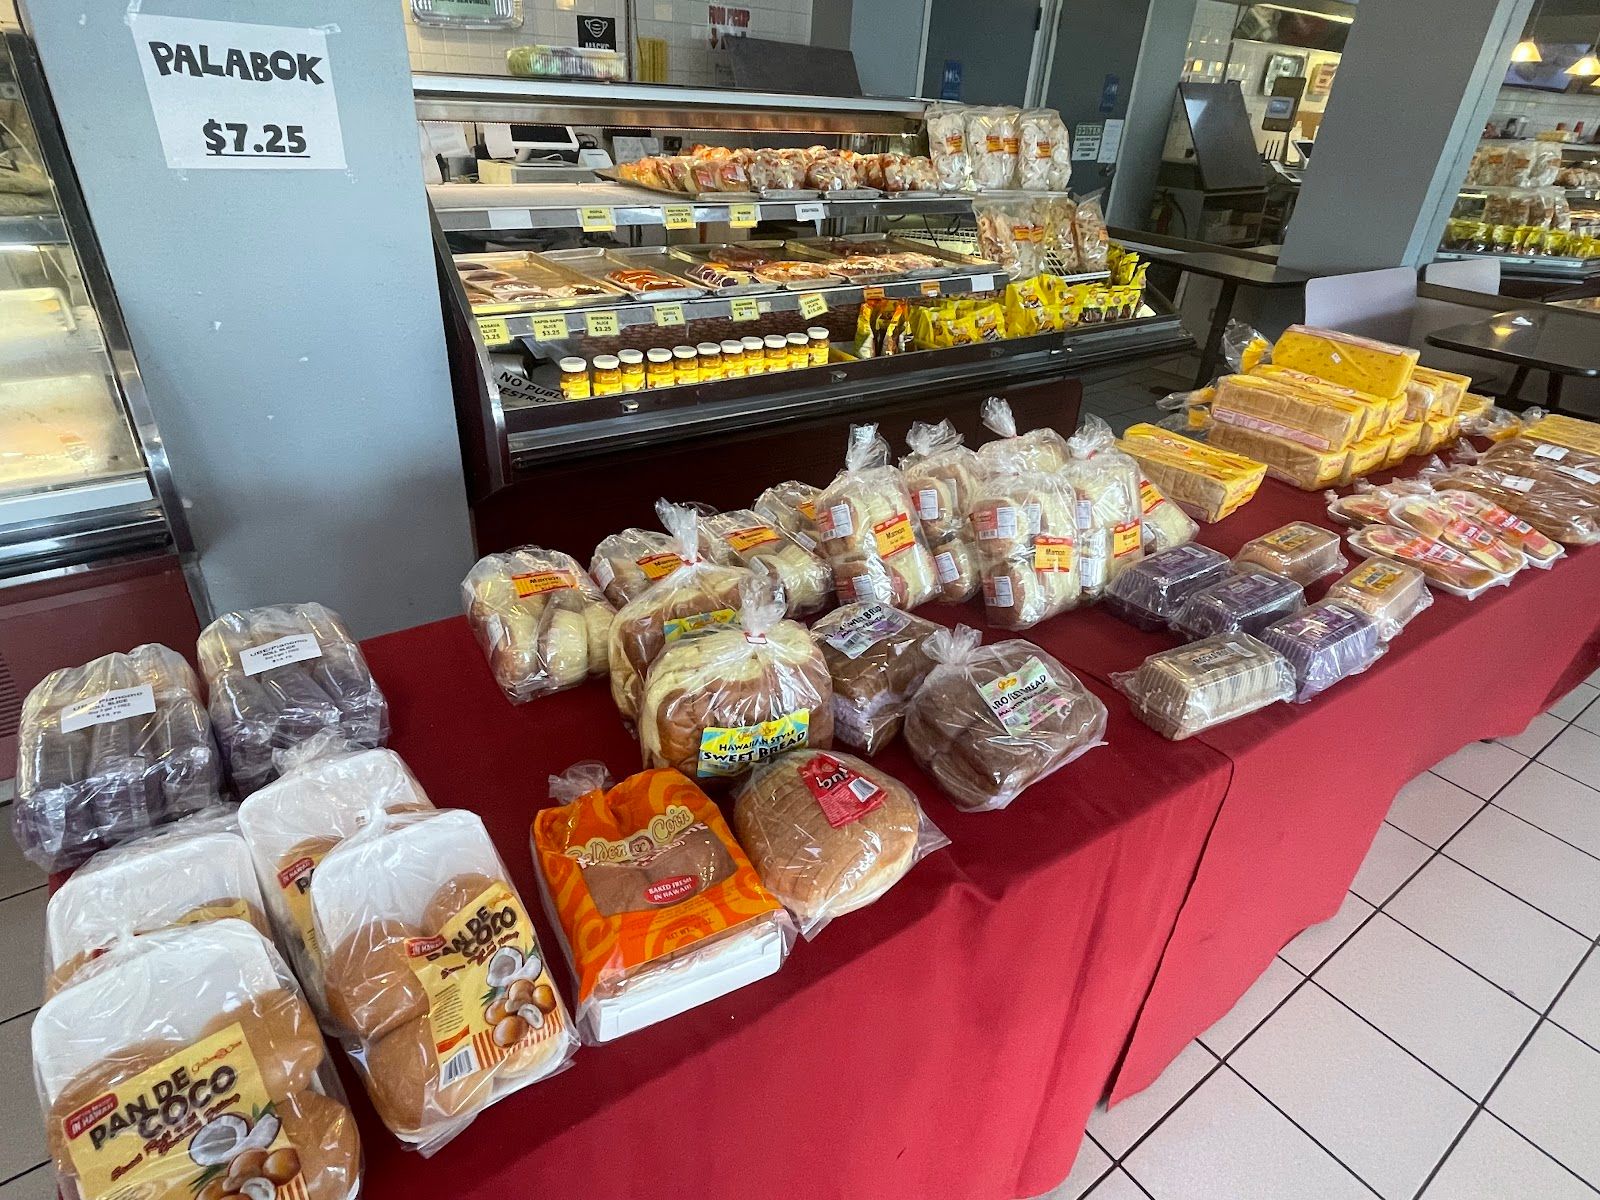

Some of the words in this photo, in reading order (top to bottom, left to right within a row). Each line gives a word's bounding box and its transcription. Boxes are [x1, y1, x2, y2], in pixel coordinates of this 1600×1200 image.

[148, 41, 325, 85] PALABOK
[202, 118, 307, 155] $7.25
[499, 371, 521, 388] NO
[524, 382, 563, 400] PUBL
[703, 750, 755, 763] SWEET
[758, 731, 807, 758] BREAD
[719, 737, 769, 752] HAWAIIAN
[648, 883, 672, 895] BAKED
[671, 876, 693, 890] FRESH
[653, 892, 663, 902] IN
[465, 905, 490, 936] DE
[89, 1094, 151, 1150] PAN
[152, 1066, 190, 1106] DE
[137, 1065, 237, 1139] COCO
